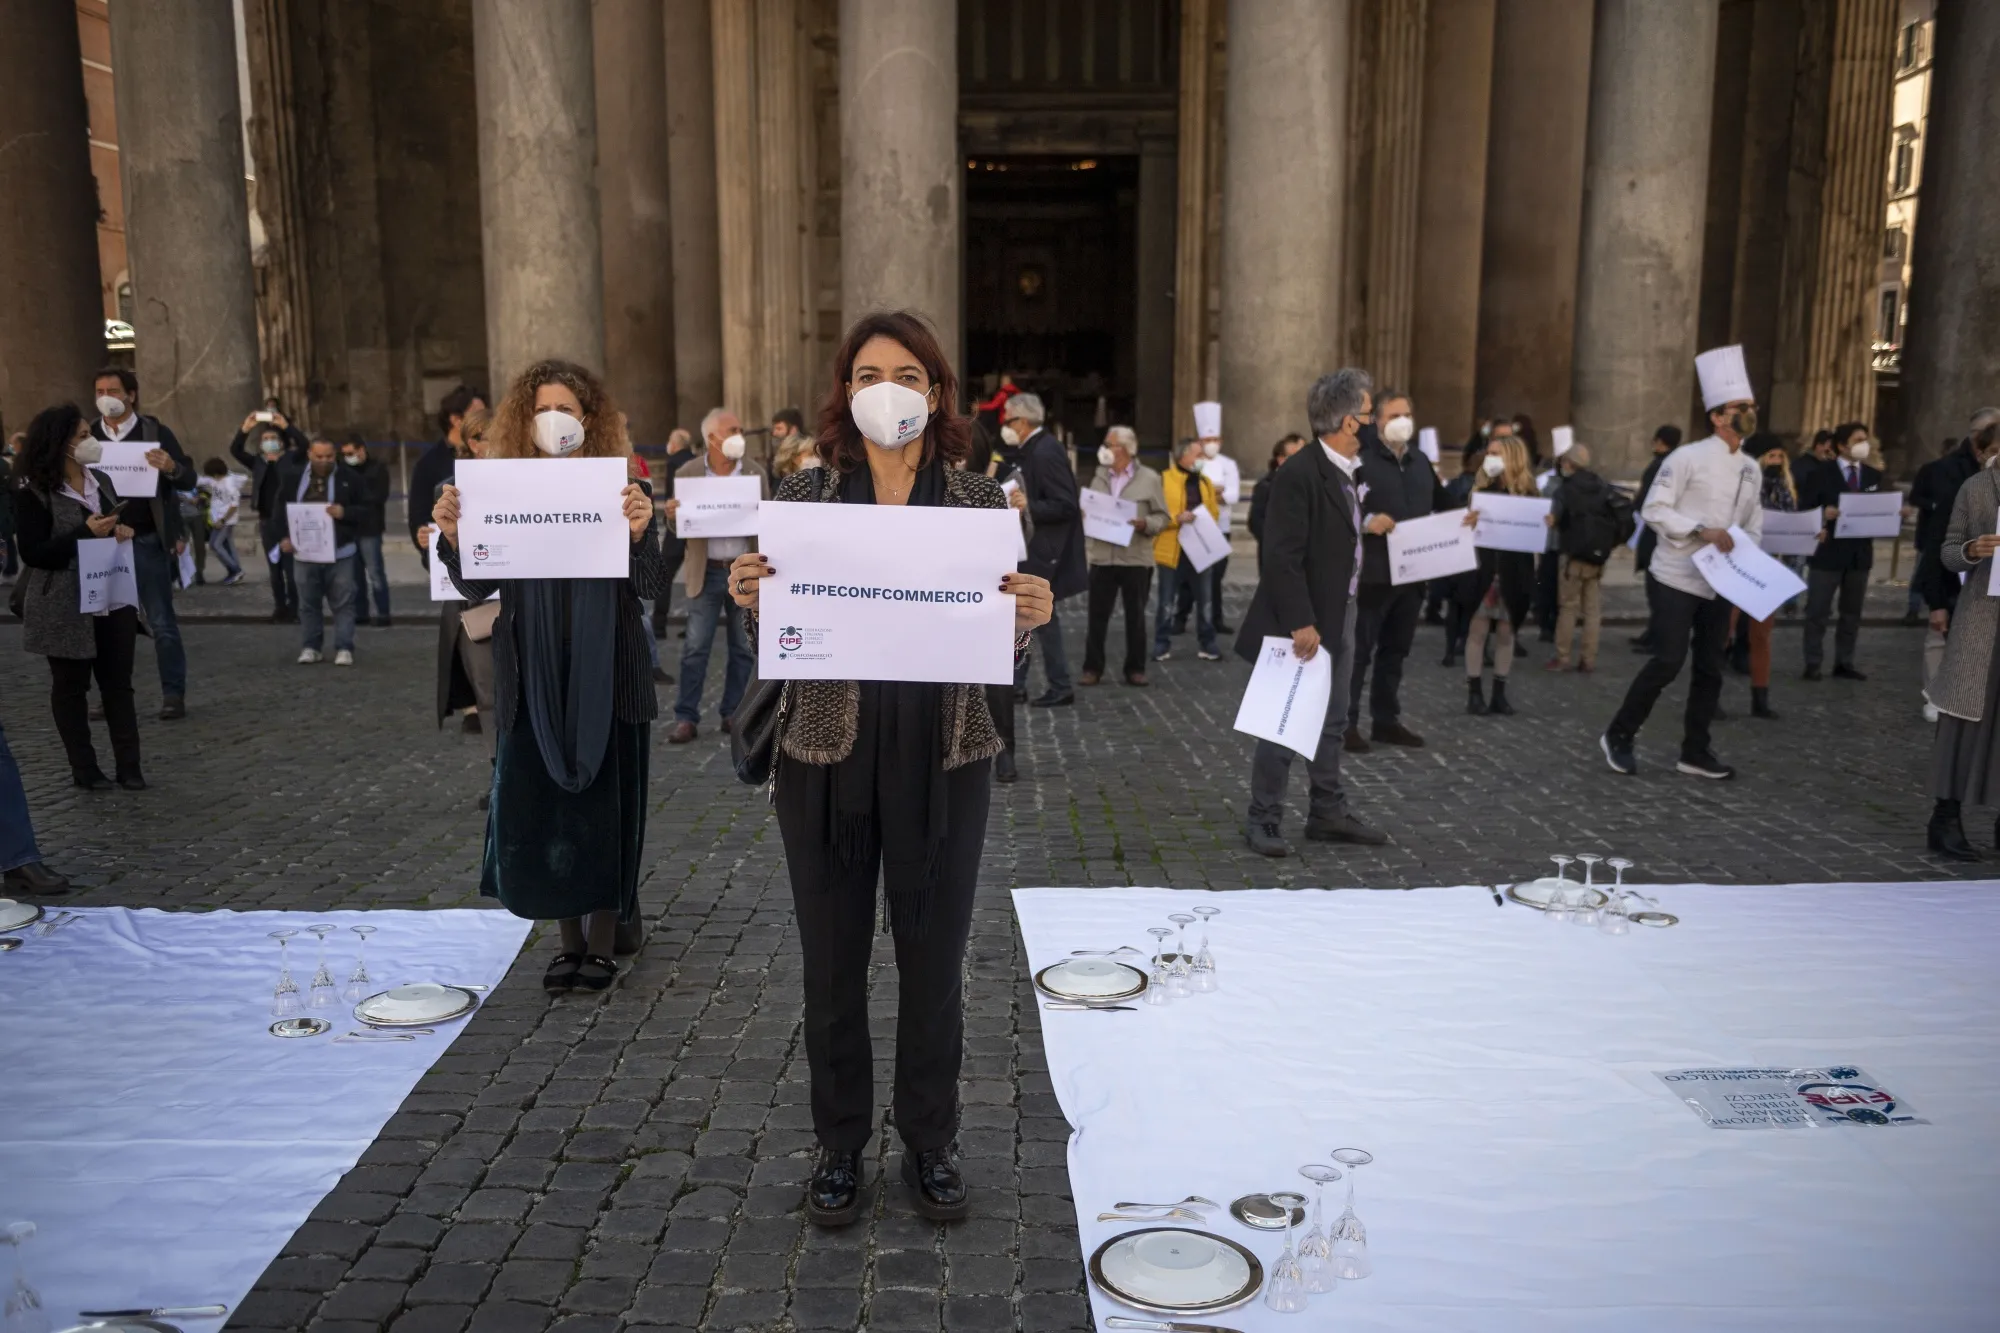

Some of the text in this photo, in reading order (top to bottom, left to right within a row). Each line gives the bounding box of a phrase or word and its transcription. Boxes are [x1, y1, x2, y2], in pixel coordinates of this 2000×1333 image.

[484, 512, 603, 525] #SIAMOATERRA
[1402, 537, 1460, 556] #DISCOTECHE
[790, 583, 984, 604] #FIPECONFCOMMERCIO
[779, 637, 803, 645] FIPE
[1664, 1073, 1821, 1082] CONFCOMMERCIO
[1723, 1092, 1791, 1102] ESERCIZI
[1797, 1091, 1895, 1106] FIPE
[1729, 1100, 1799, 1109] PUBBLICI
